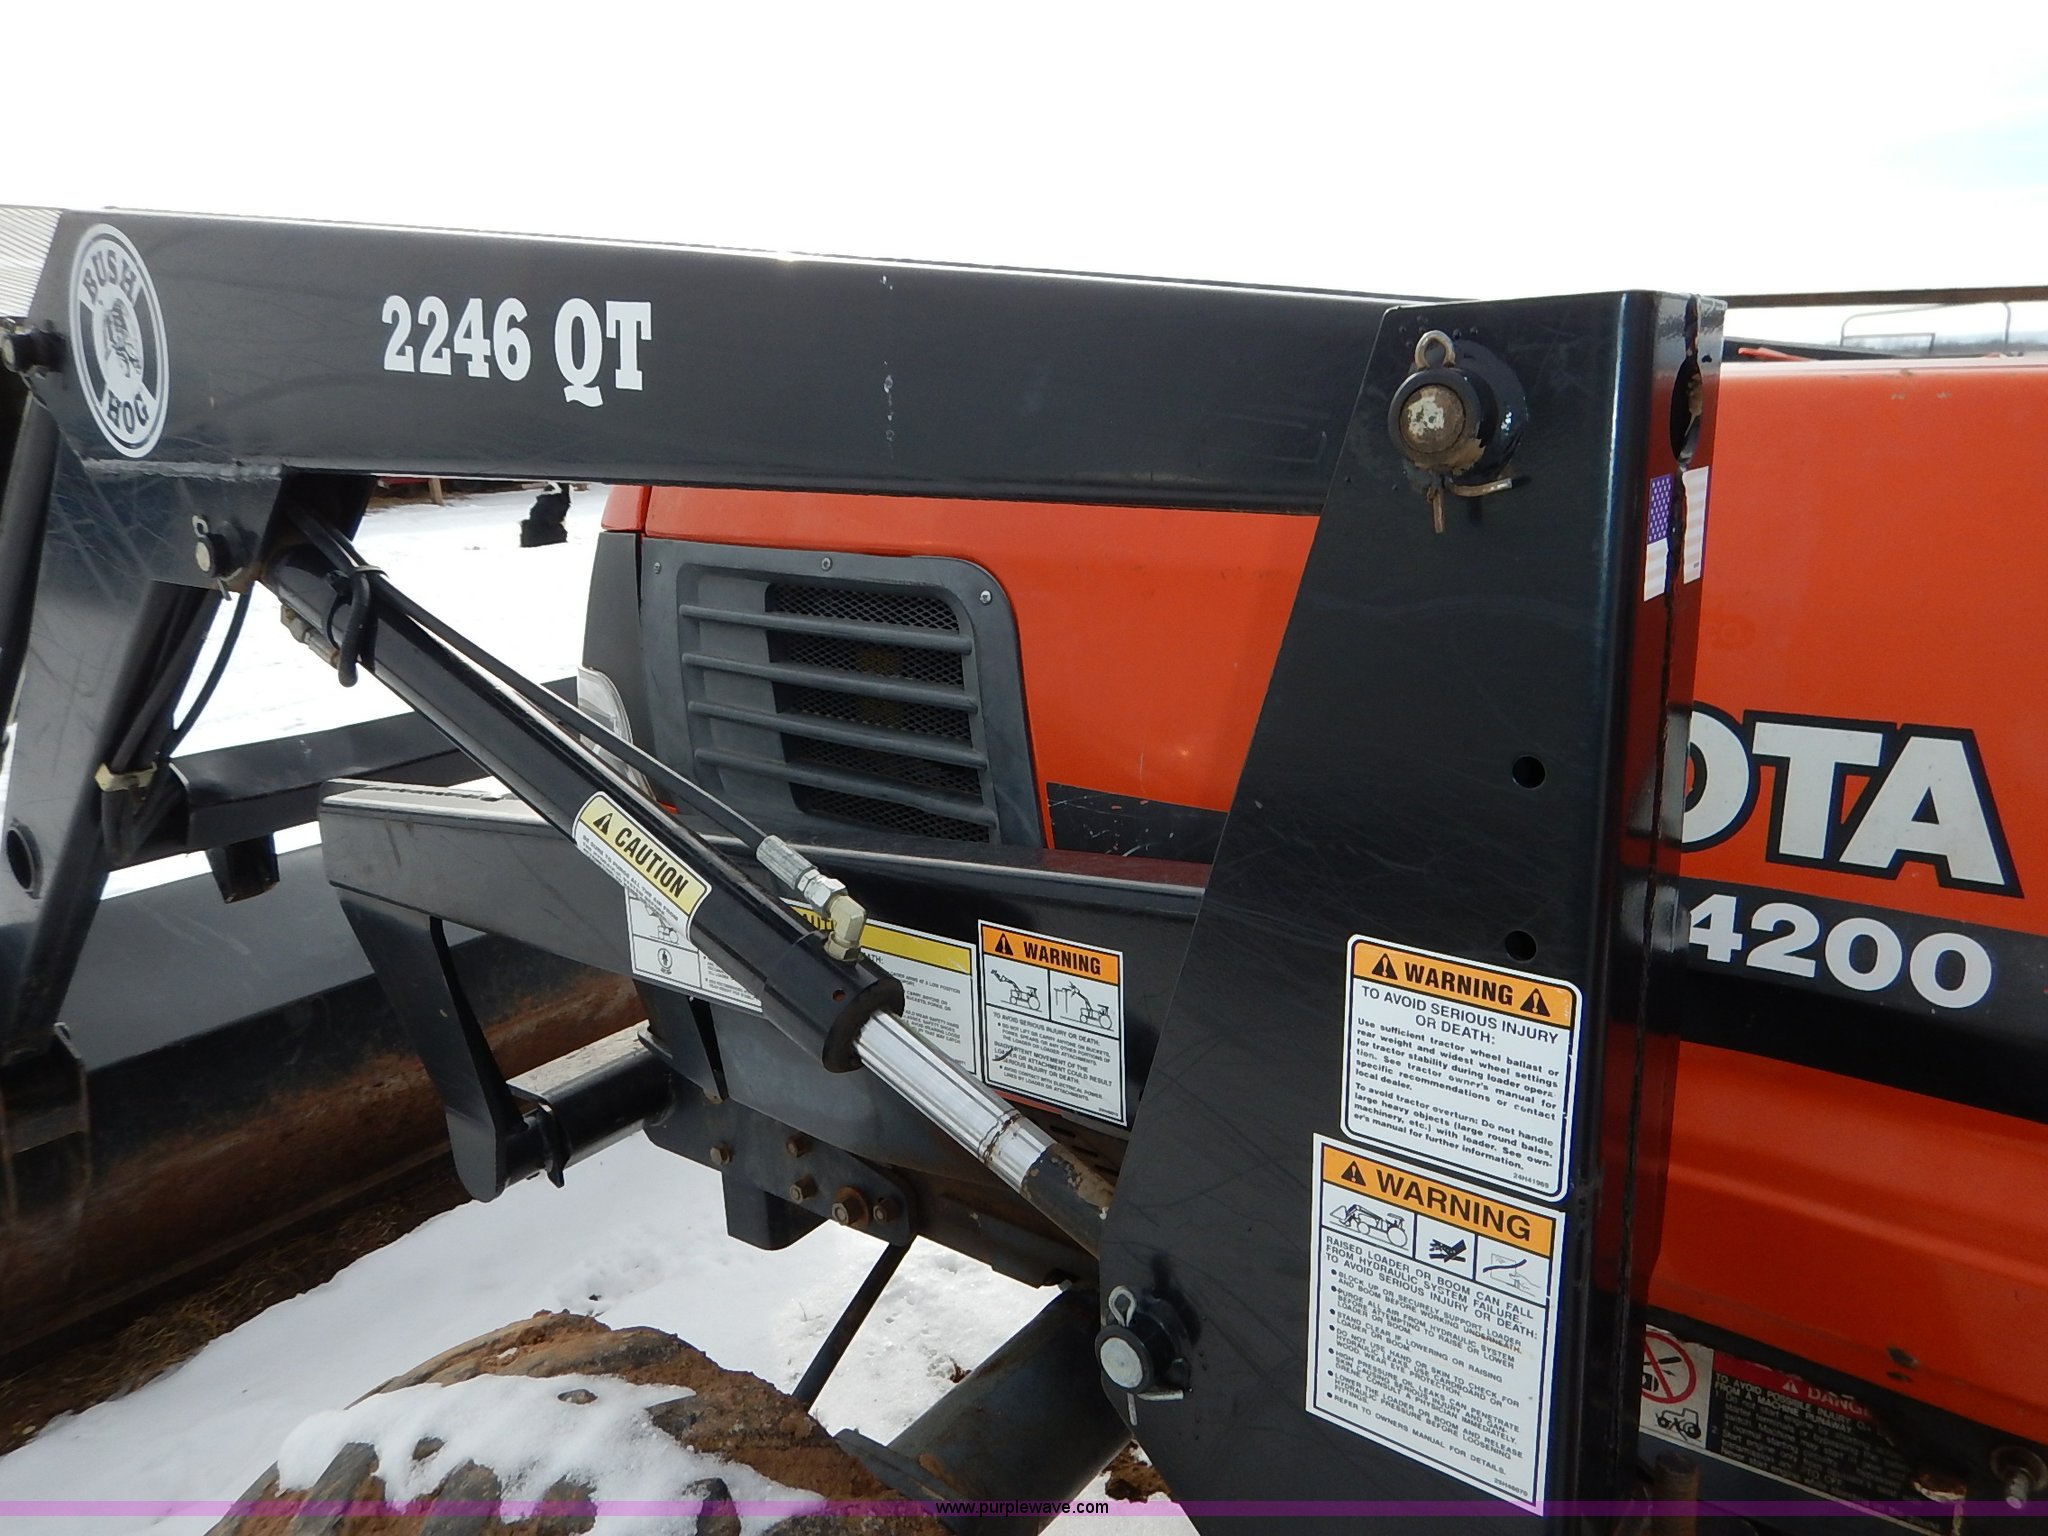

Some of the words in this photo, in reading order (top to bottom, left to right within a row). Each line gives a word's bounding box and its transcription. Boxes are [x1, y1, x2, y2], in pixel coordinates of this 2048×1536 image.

[82, 249, 137, 305] BUSH
[382, 295, 531, 381] 2246
[555, 298, 652, 407] QT
[107, 388, 149, 434] HOG
[615, 828, 689, 898] CAUTION
[1022, 941, 1101, 975] WARNING
[1689, 894, 1992, 1008] 4200
[1404, 961, 1513, 1006] WARNING
[1361, 985, 1380, 999] TO
[1383, 991, 1426, 1011] AVOID
[1430, 1002, 1497, 1029] SERIOUS
[1501, 1020, 1559, 1044] INJURY
[1415, 1014, 1436, 1029] OR
[1440, 1020, 1495, 1045] DEATH:
[1356, 1029, 1376, 1039] rear
[1379, 1035, 1412, 1049] weight
[1416, 1045, 1435, 1055] and
[1439, 1051, 1473, 1065] widest
[1478, 1061, 1510, 1075] wheel
[1514, 1071, 1558, 1088] settings
[1356, 1037, 1369, 1047] for
[1372, 1042, 1405, 1057] tractor
[1408, 1053, 1448, 1070] stability
[1451, 1064, 1484, 1080] during
[1486, 1073, 1520, 1088] loader
[1357, 1017, 1375, 1028] Use
[1380, 1024, 1425, 1042] sufficient
[1429, 1036, 1465, 1052] tractor
[1469, 1048, 1501, 1062] wheel
[1505, 1056, 1542, 1073] ballast
[1547, 1069, 1559, 1077] or
[1355, 1068, 1378, 1081] local
[1380, 1075, 1412, 1090] dealer.
[1356, 1059, 1393, 1075] specific
[1398, 1071, 1490, 1102] recommendations
[1496, 1099, 1508, 1107] or
[1383, 1055, 1401, 1067] See
[1407, 1062, 1442, 1078] tractor
[1448, 1074, 1489, 1091] owner's
[1494, 1087, 1535, 1104] manual
[1541, 1098, 1557, 1110] for
[1353, 1113, 1370, 1122] er's
[1372, 1118, 1407, 1133] manual
[1409, 1128, 1423, 1138] for
[1425, 1133, 1459, 1149] further
[1461, 1144, 1524, 1170] information.
[1354, 1092, 1378, 1105] large
[1381, 1100, 1409, 1115] heavy
[1413, 1110, 1450, 1126] objects
[1453, 1121, 1483, 1136] (large
[1487, 1132, 1517, 1147] round
[1521, 1141, 1553, 1158] bales,
[1354, 1103, 1404, 1124] machinery,
[1436, 1127, 1458, 1139] with
[1462, 1134, 1497, 1151] loader.
[1502, 1146, 1522, 1159] See
[1526, 1155, 1552, 1167] own-
[1355, 1081, 1366, 1091] To
[1368, 1087, 1394, 1099] avoid
[1395, 1094, 1430, 1110] tractor
[1431, 1106, 1478, 1125] overturn:
[1481, 1118, 1495, 1129] Do
[1497, 1125, 1515, 1135] not
[1518, 1129, 1554, 1147] handle
[1375, 1168, 1530, 1242] WARNING
[1325, 1243, 1354, 1261] FROM
[1358, 1256, 1418, 1285] HYDRAULIC
[1423, 1280, 1467, 1304] SYSTEM
[1473, 1298, 1523, 1325] FAILURE.
[1325, 1251, 1339, 1263] TO
[1343, 1259, 1373, 1277] AVOID
[1378, 1272, 1425, 1296] SERIOUS
[1429, 1291, 1468, 1313] INJURY
[1474, 1309, 1491, 1322] OR
[1496, 1317, 1537, 1340] DEATH:
[1326, 1235, 1363, 1255] RAISED
[1367, 1250, 1410, 1273] LOADER
[1415, 1268, 1431, 1281] OR
[1436, 1275, 1470, 1296] BOOM
[1475, 1291, 1500, 1307] CAN
[1505, 1301, 1534, 1320] FALL
